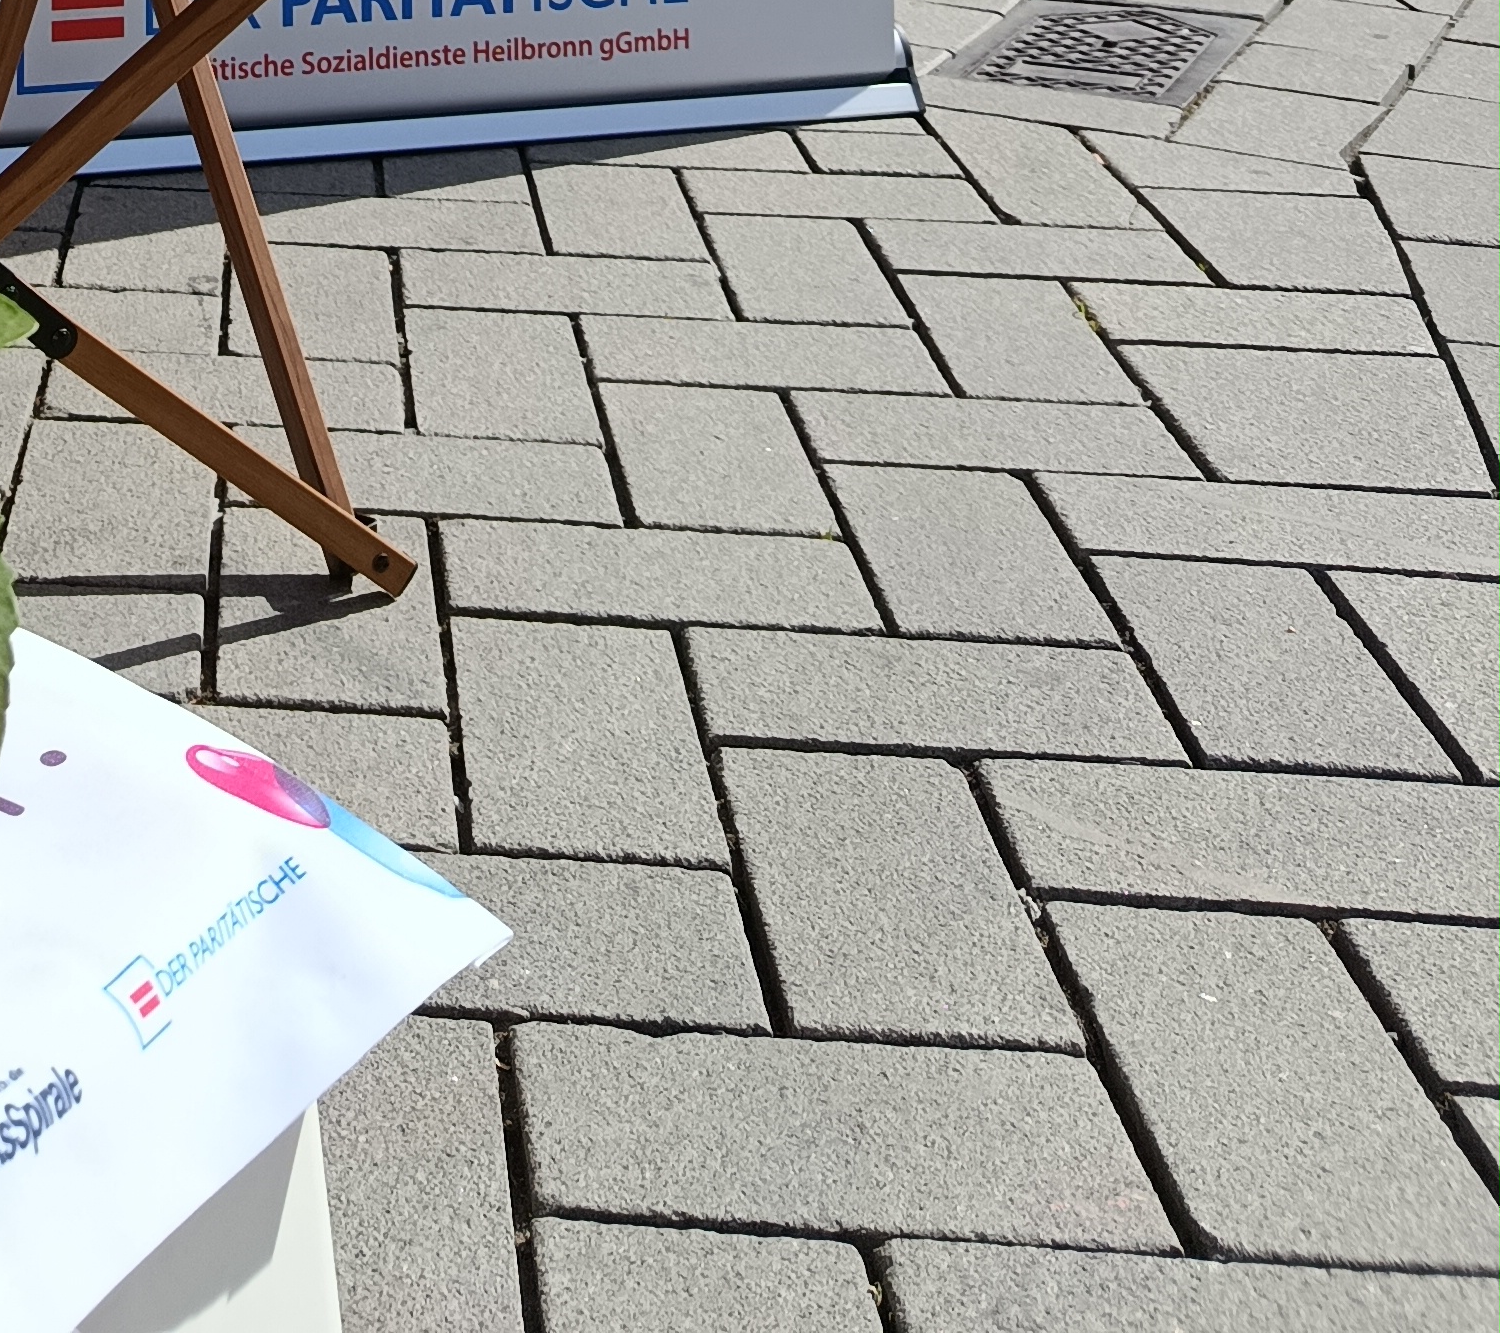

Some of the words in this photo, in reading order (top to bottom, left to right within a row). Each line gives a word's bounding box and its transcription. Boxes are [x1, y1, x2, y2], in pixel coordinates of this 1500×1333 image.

[302, 45, 466, 74] Sozialdienste
[473, 37, 592, 63] Heilbronn
[600, 28, 689, 61] gGmbH
[155, 953, 194, 997] DER
[188, 856, 307, 970] PARITÄTISCHE
